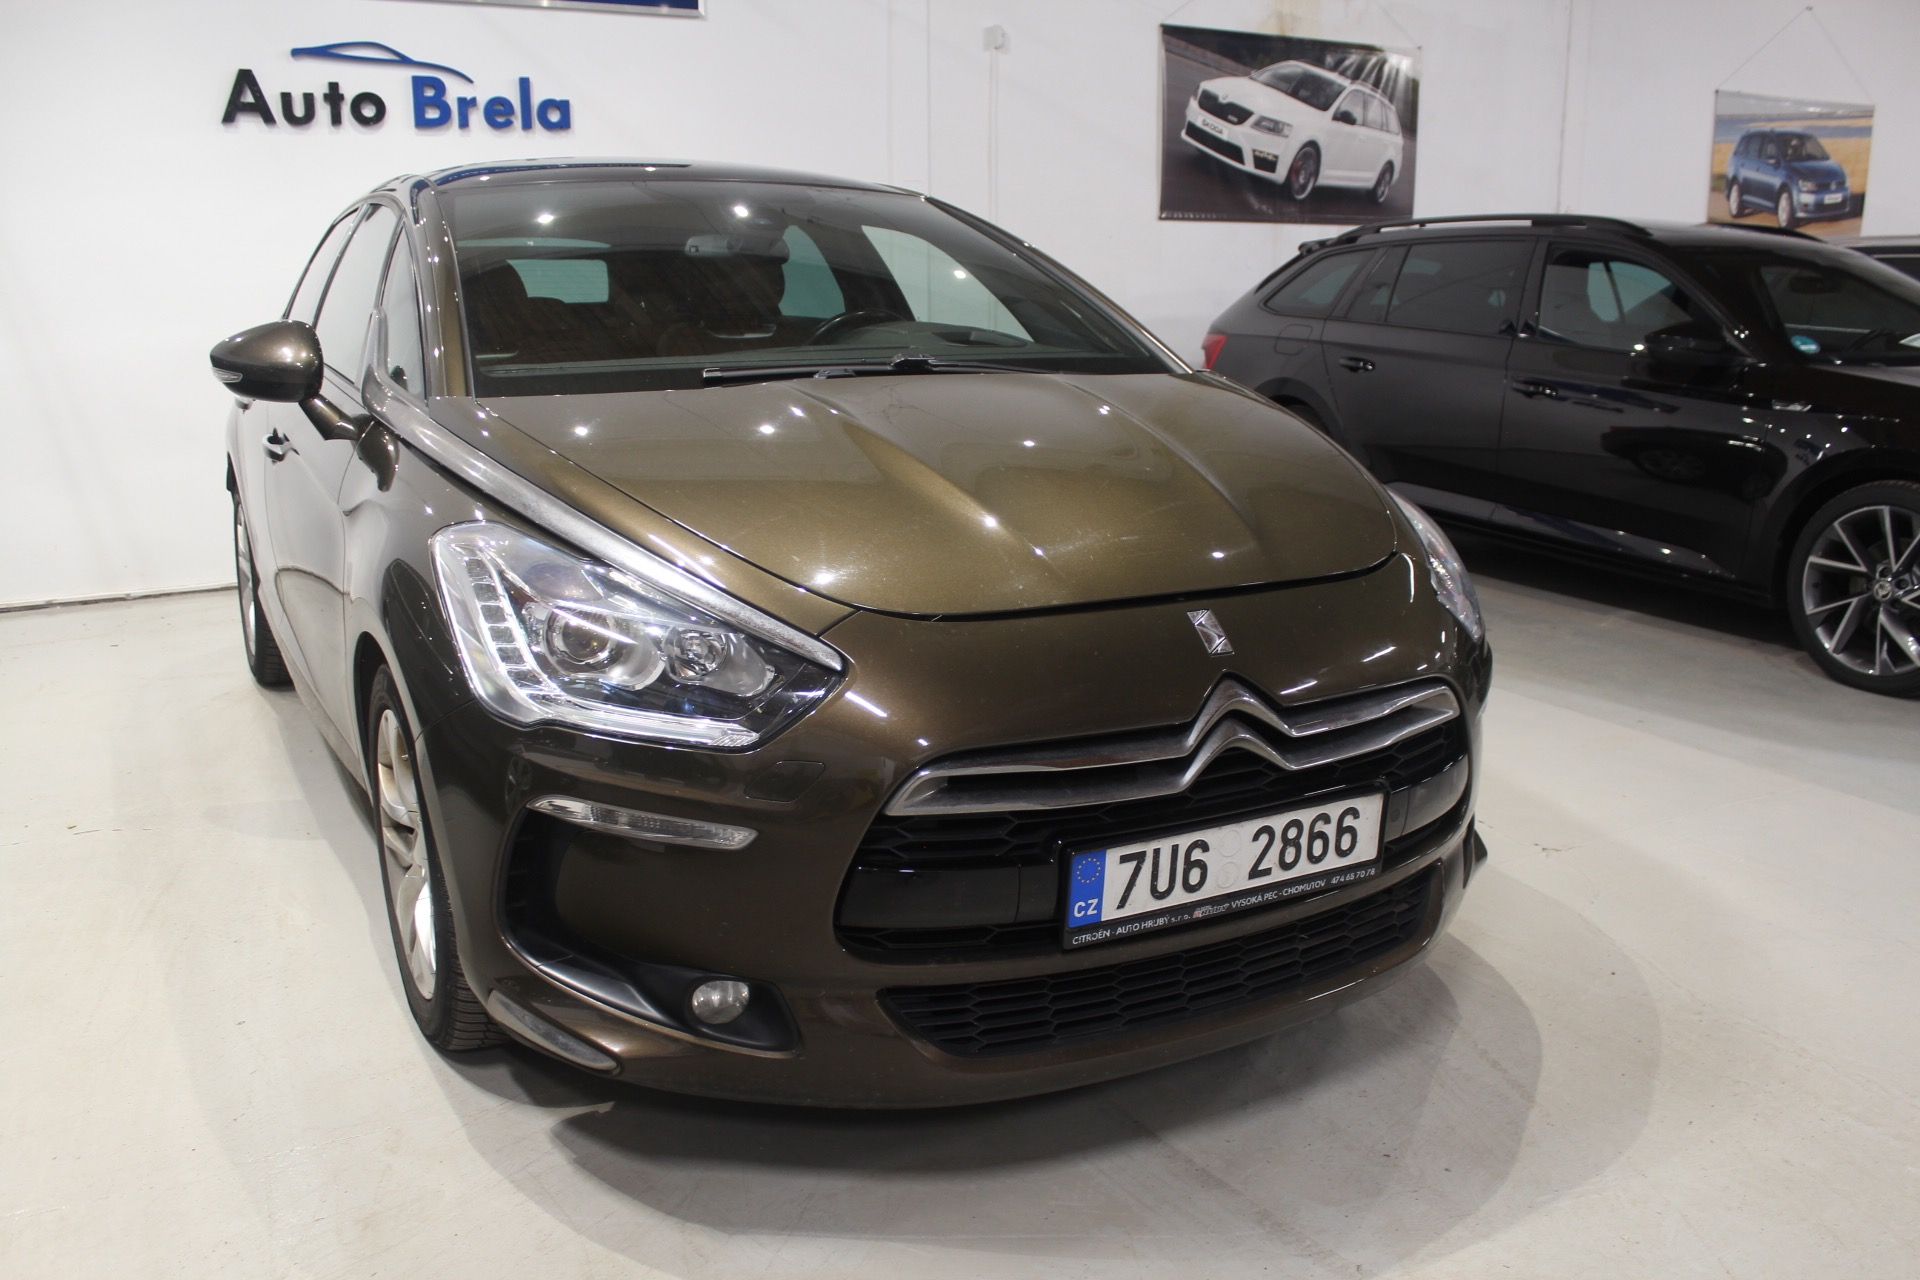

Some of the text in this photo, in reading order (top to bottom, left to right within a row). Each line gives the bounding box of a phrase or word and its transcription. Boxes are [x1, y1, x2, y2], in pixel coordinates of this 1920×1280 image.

[221, 68, 572, 130] Auto Brela
[1116, 806, 1360, 910] 7U6 2866
[1074, 897, 1099, 918] CZ
[1116, 921, 1141, 935] AUTO
[1283, 880, 1326, 897] CHOMUTOV
